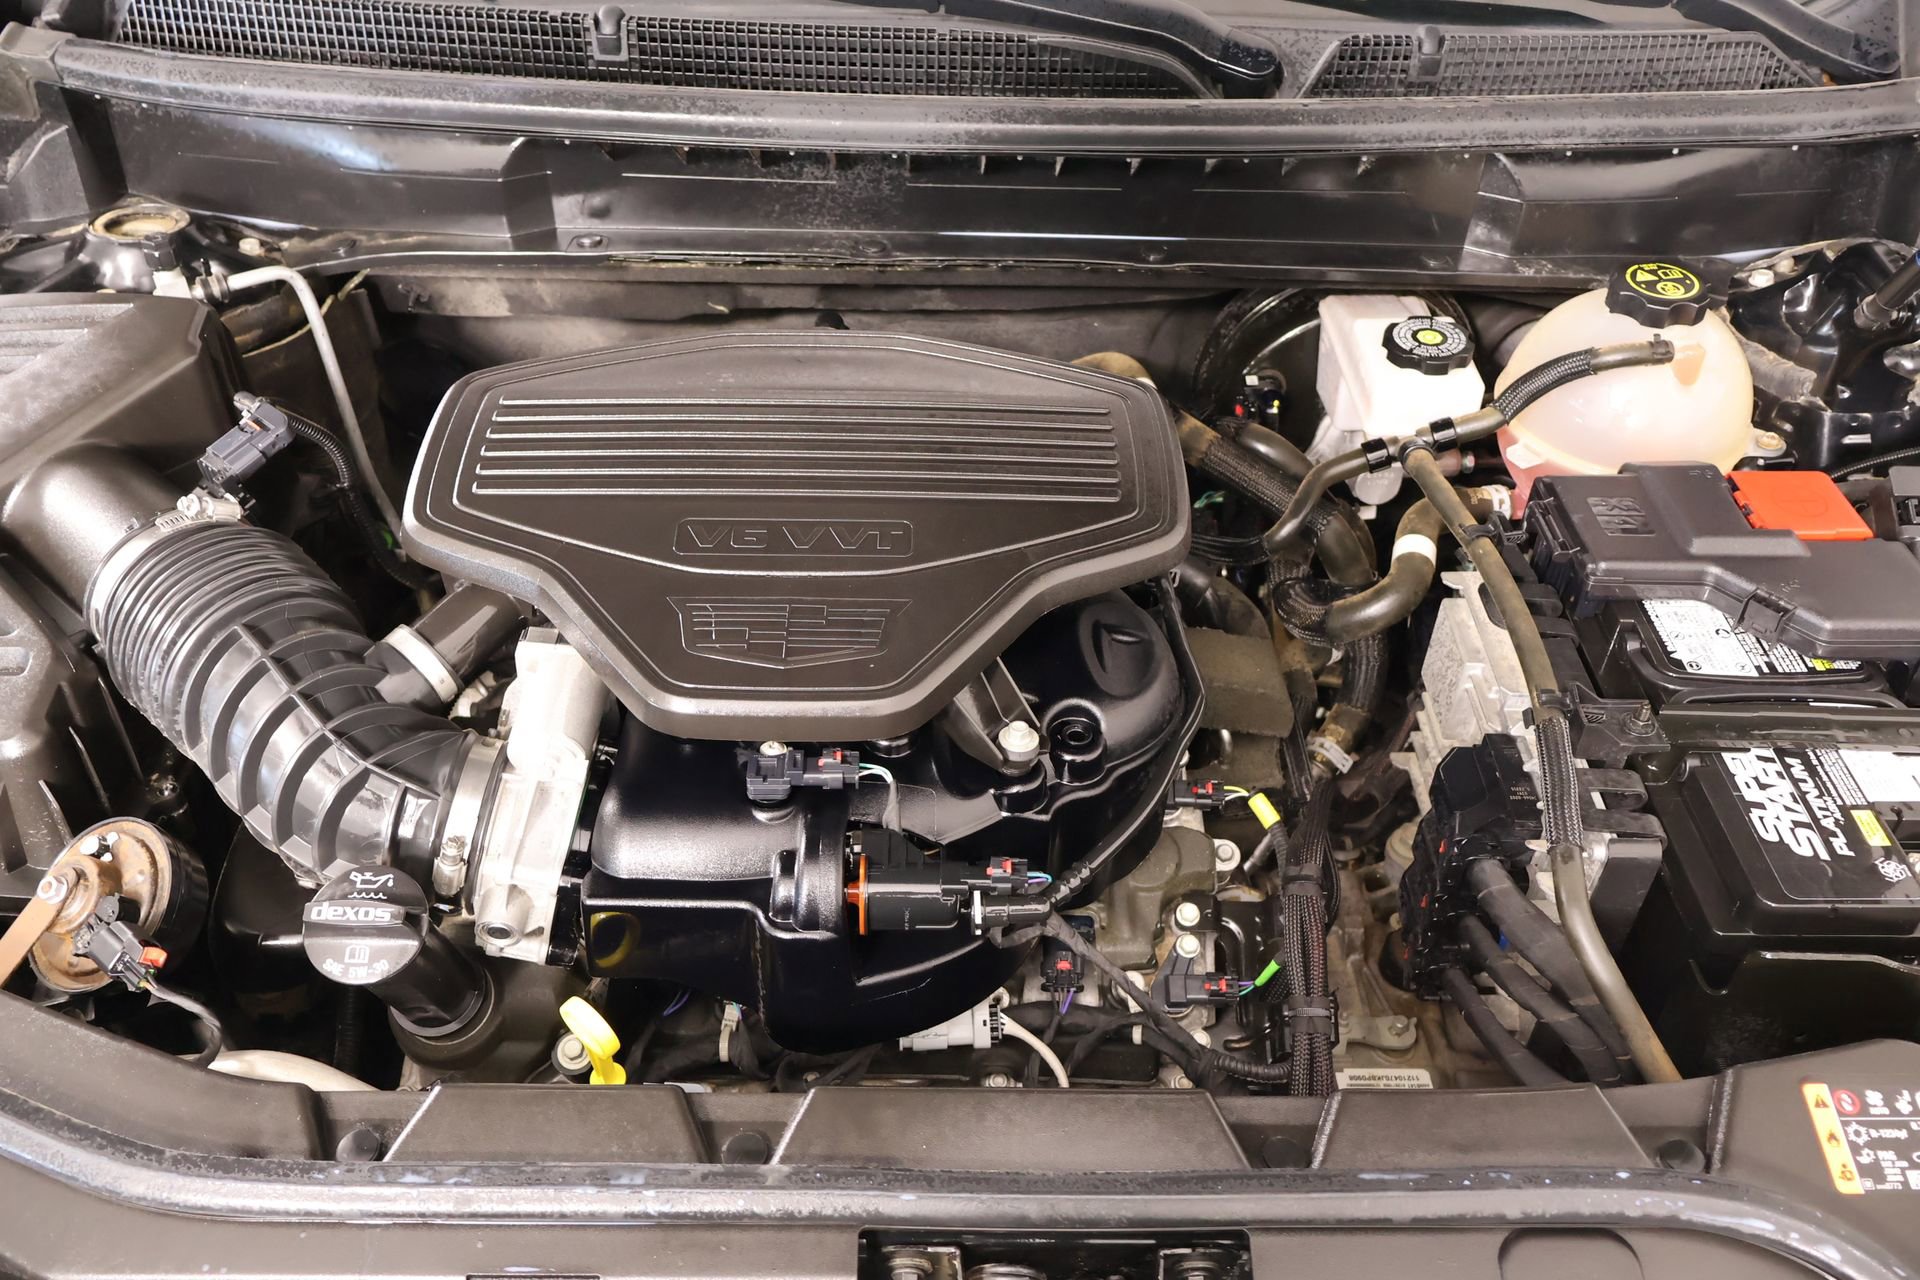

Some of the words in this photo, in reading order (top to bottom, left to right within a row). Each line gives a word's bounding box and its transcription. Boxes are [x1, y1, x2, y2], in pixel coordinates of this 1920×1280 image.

[687, 525, 768, 549] V6
[781, 526, 904, 550] VVT
[1784, 757, 1855, 857] PLATINUM
[311, 902, 394, 922] dexos
[323, 958, 345, 977] SAE
[349, 959, 389, 977] 5W-30
